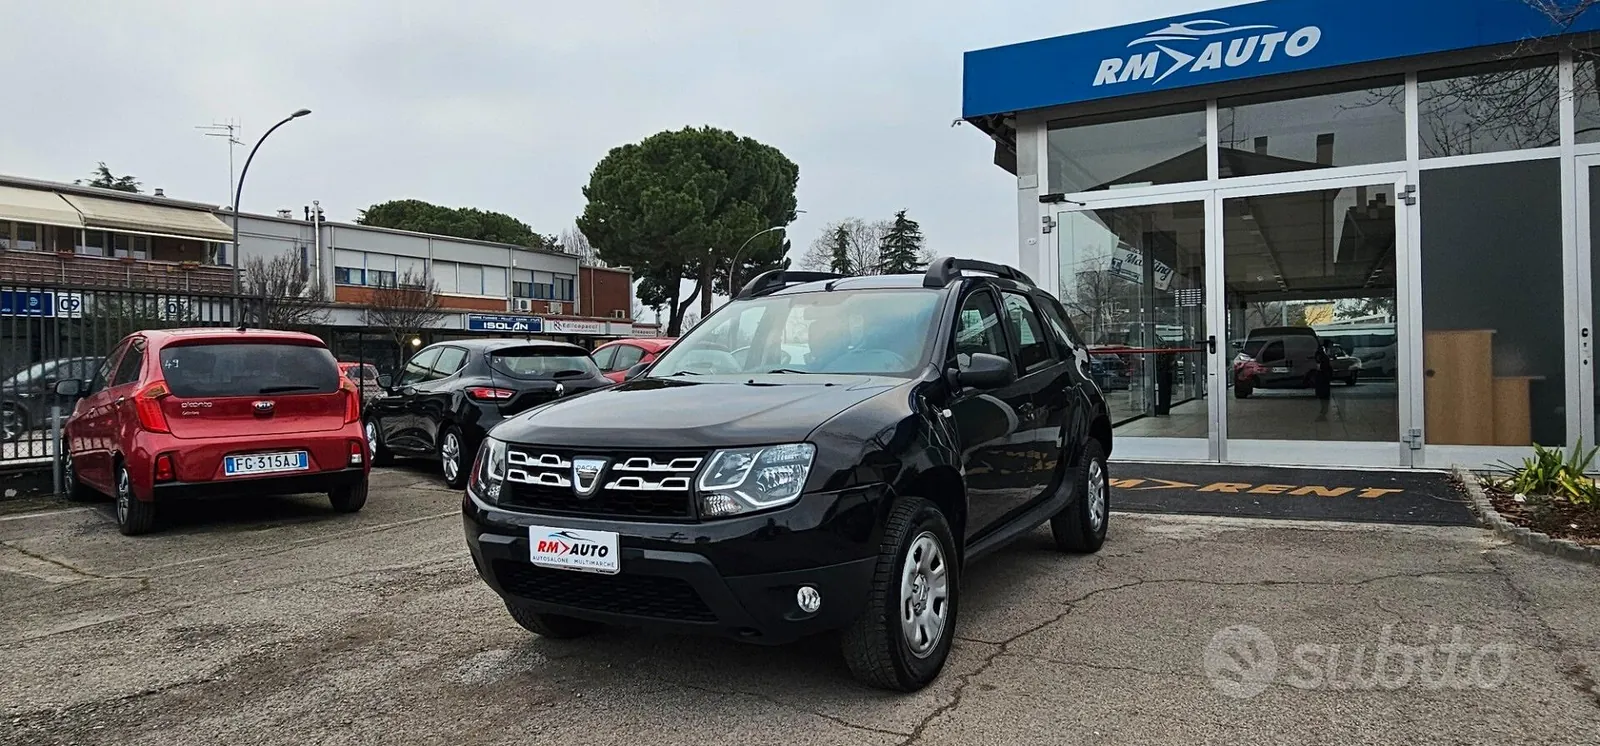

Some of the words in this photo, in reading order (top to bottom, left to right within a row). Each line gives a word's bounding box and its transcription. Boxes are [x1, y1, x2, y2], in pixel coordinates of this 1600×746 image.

[1189, 25, 1322, 73] AUTO
[60, 298, 80, 310] 09
[483, 321, 528, 332] ISOLAN
[1196, 481, 1404, 498] RENT
[569, 543, 609, 558] AUTO
[532, 555, 569, 564] AUTOSALONE
[573, 559, 616, 568] MULTIMARCHE
